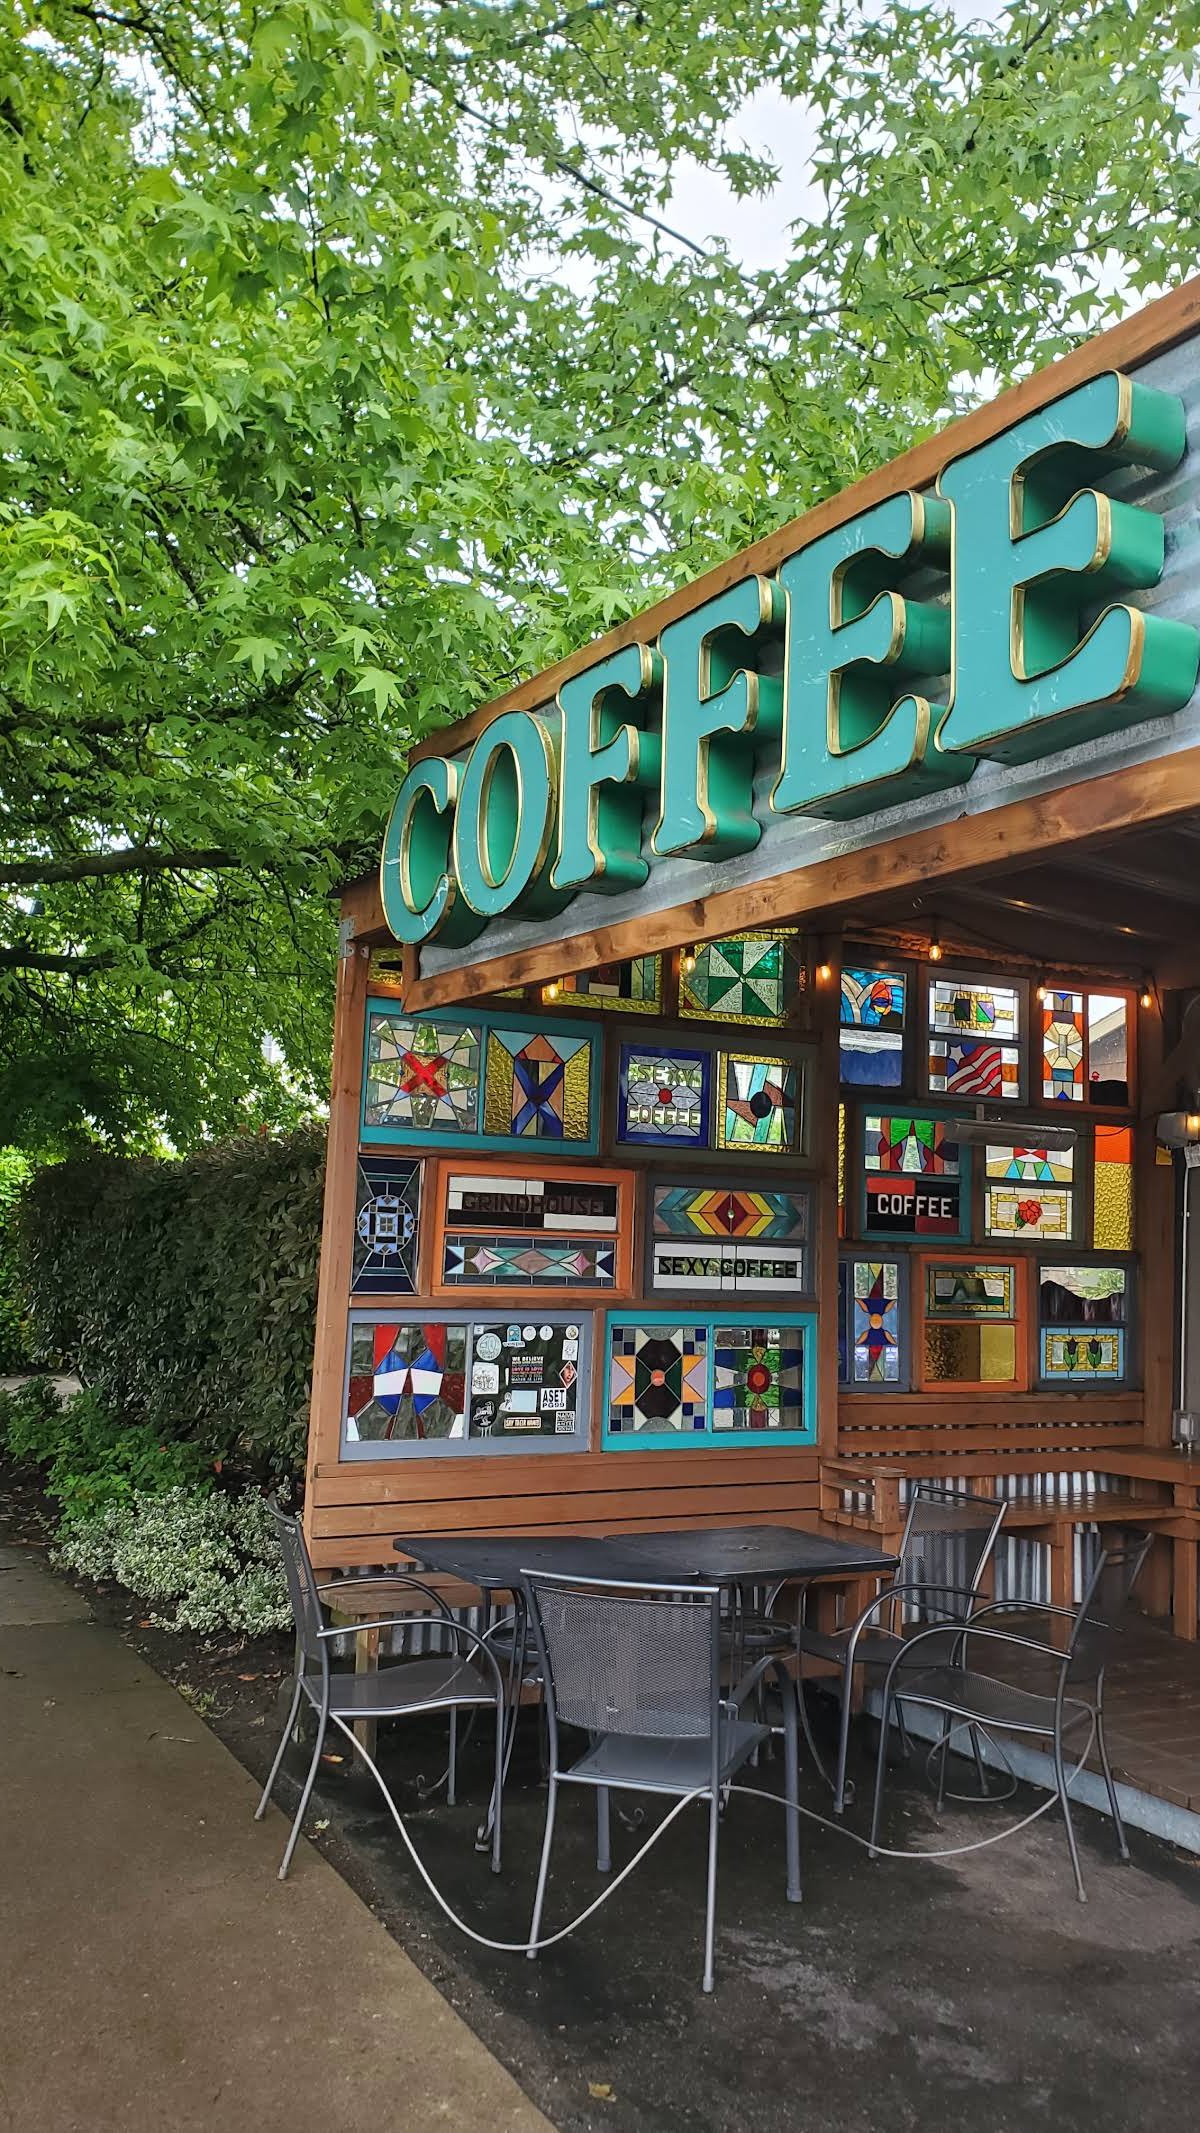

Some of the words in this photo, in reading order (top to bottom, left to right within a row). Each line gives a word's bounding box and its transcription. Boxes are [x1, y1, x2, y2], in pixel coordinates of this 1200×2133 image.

[380, 368, 1190, 946] COFFEE
[637, 1065, 694, 1087] SEXY
[627, 1105, 702, 1127] COFFEE
[463, 1192, 604, 1216] GRINDHOUSE
[877, 1193, 953, 1219] COFFEE
[659, 1257, 710, 1277] SEXY
[720, 1259, 797, 1279] COFFEE
[542, 1389, 565, 1403] ASET
